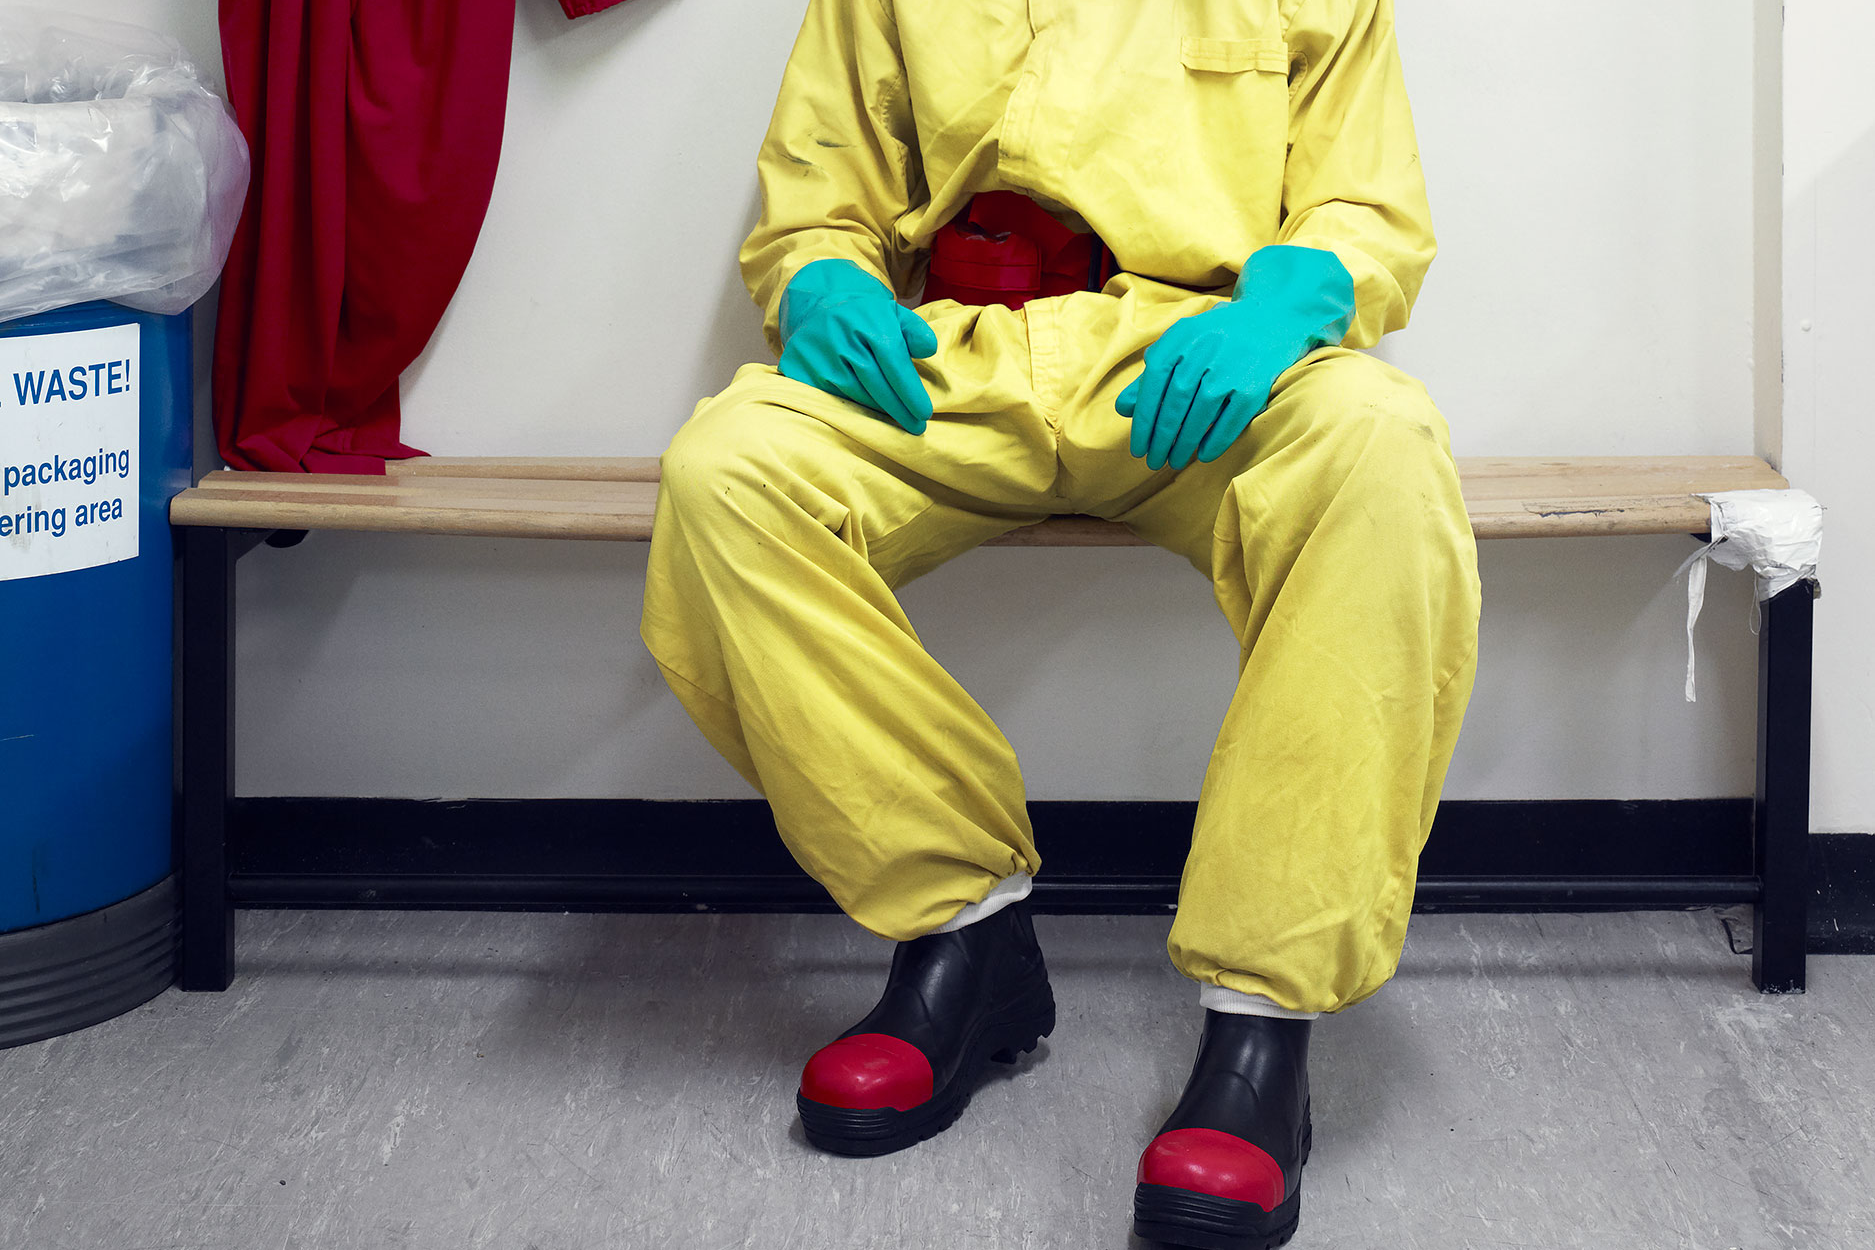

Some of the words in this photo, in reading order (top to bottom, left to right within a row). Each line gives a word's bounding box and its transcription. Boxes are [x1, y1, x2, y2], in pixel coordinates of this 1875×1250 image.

[13, 358, 131, 406] WASTE!
[4, 447, 130, 495] packaging
[75, 497, 123, 527] area
